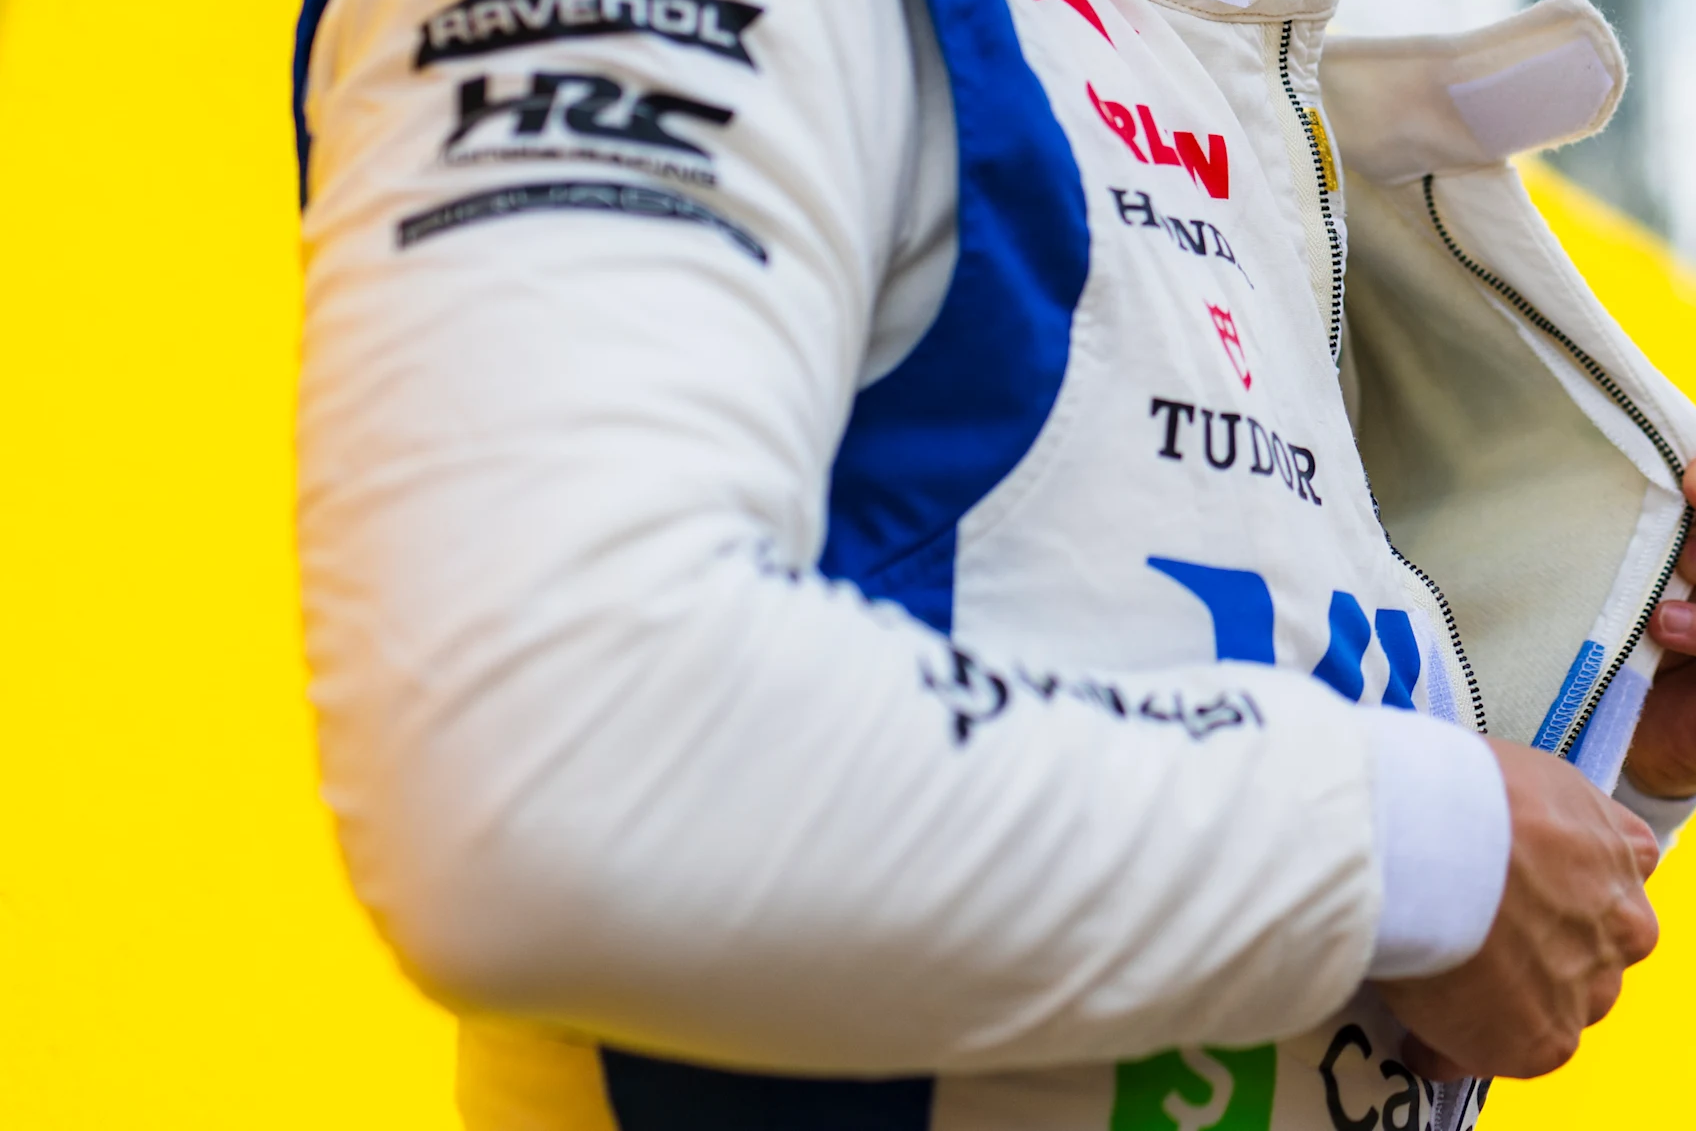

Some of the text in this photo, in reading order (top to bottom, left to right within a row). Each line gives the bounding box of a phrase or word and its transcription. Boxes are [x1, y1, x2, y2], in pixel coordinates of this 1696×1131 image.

[1086, 80, 1229, 200] RLN
[1107, 185, 1254, 290] HND
[1150, 396, 1323, 507] TUDOR
